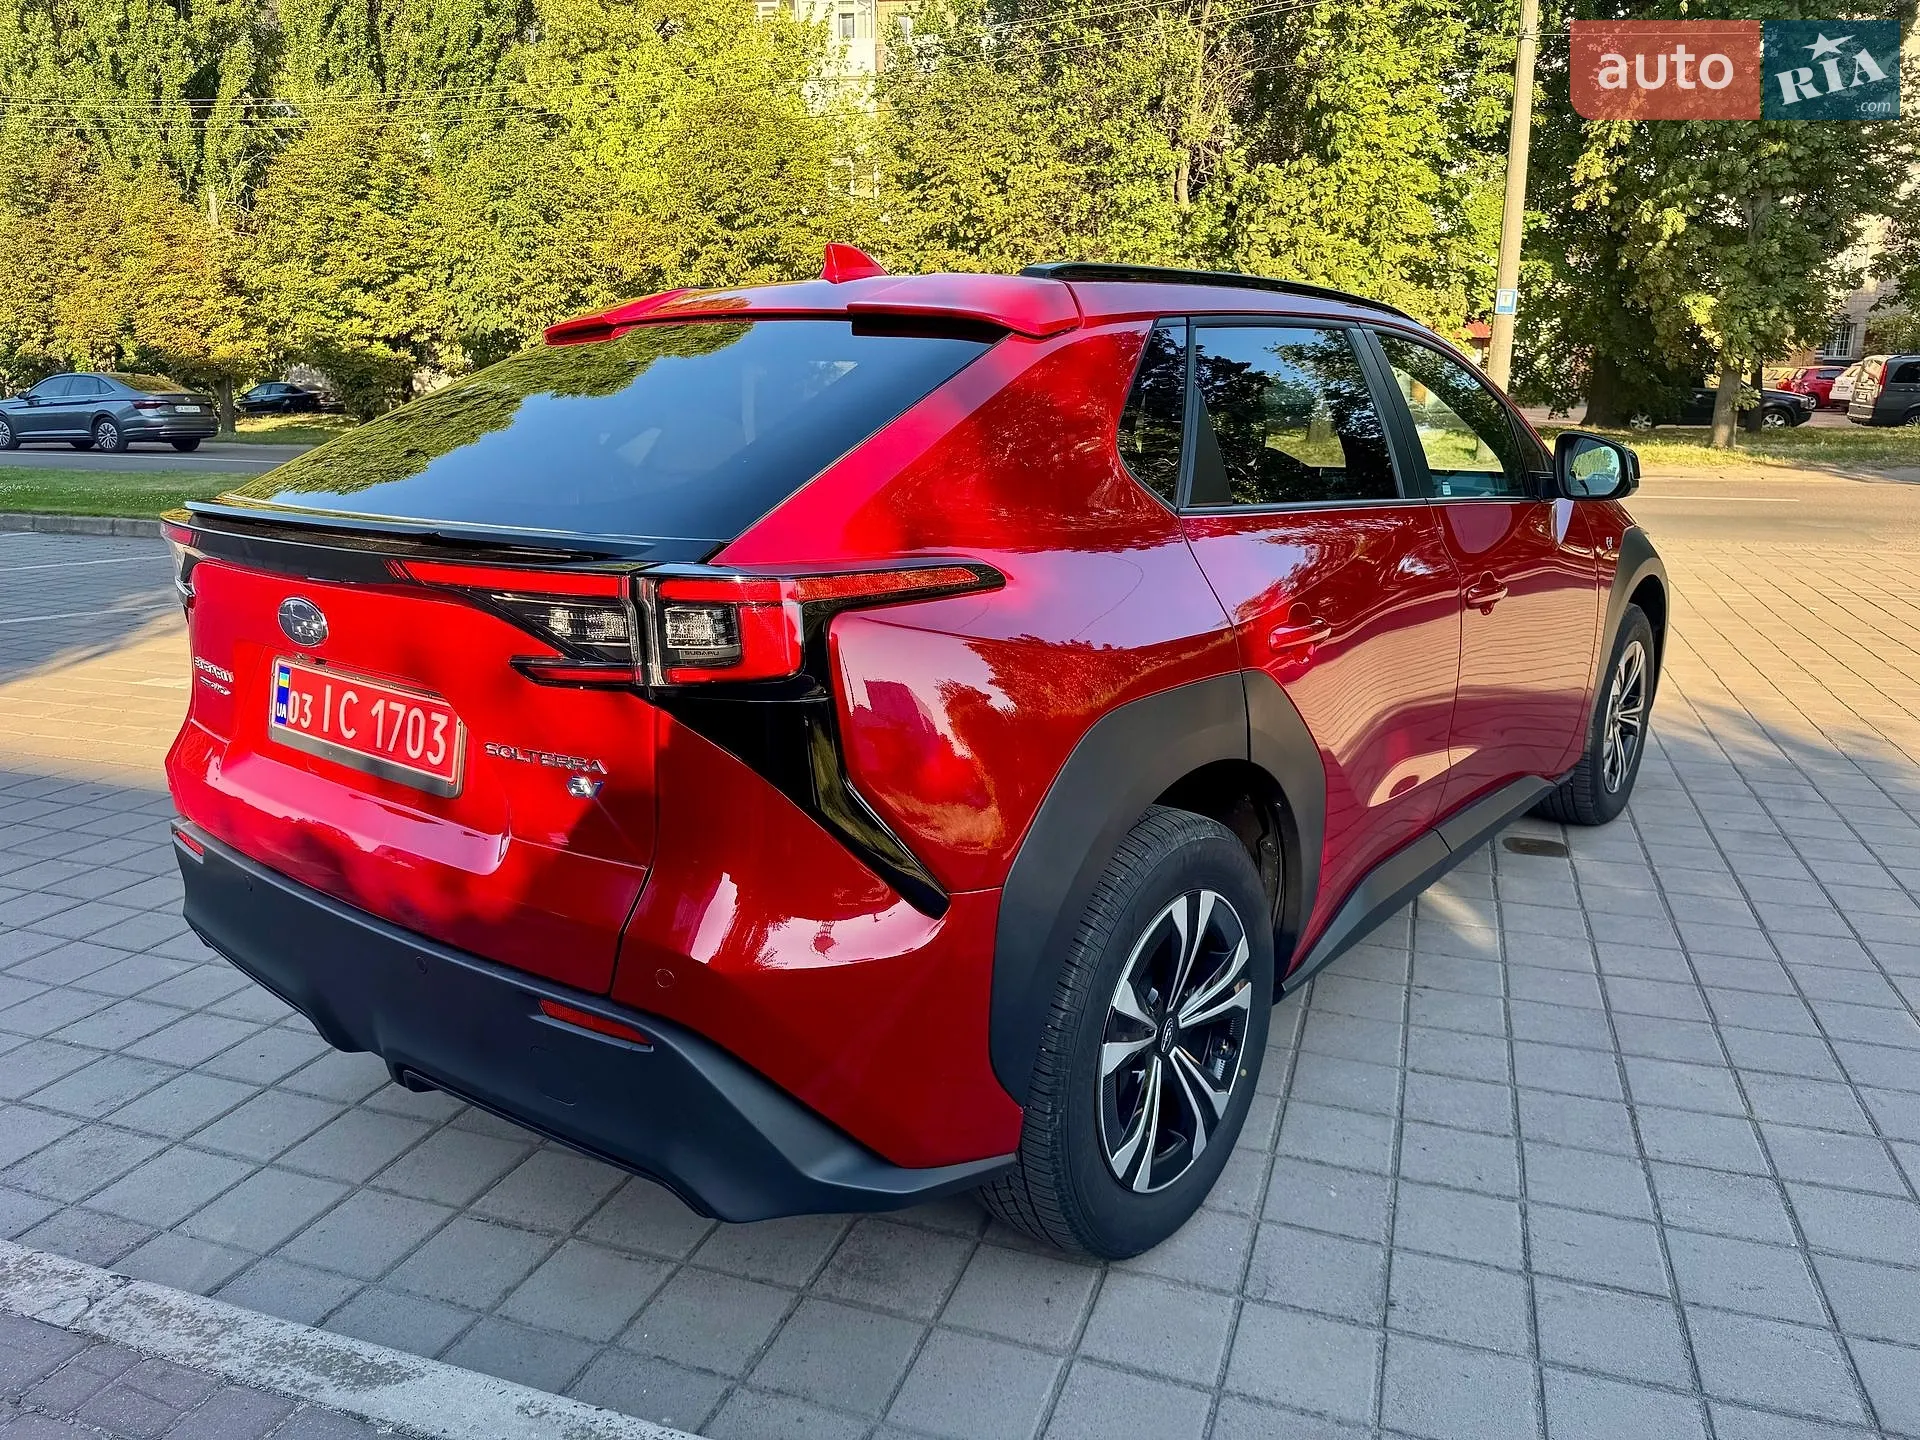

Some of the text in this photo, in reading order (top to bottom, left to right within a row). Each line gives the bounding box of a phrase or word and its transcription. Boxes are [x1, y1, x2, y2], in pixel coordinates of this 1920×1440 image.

[276, 702, 288, 719] UA
[288, 684, 449, 766] 03 IC 1703
[484, 741, 608, 775] SOLTERRA
